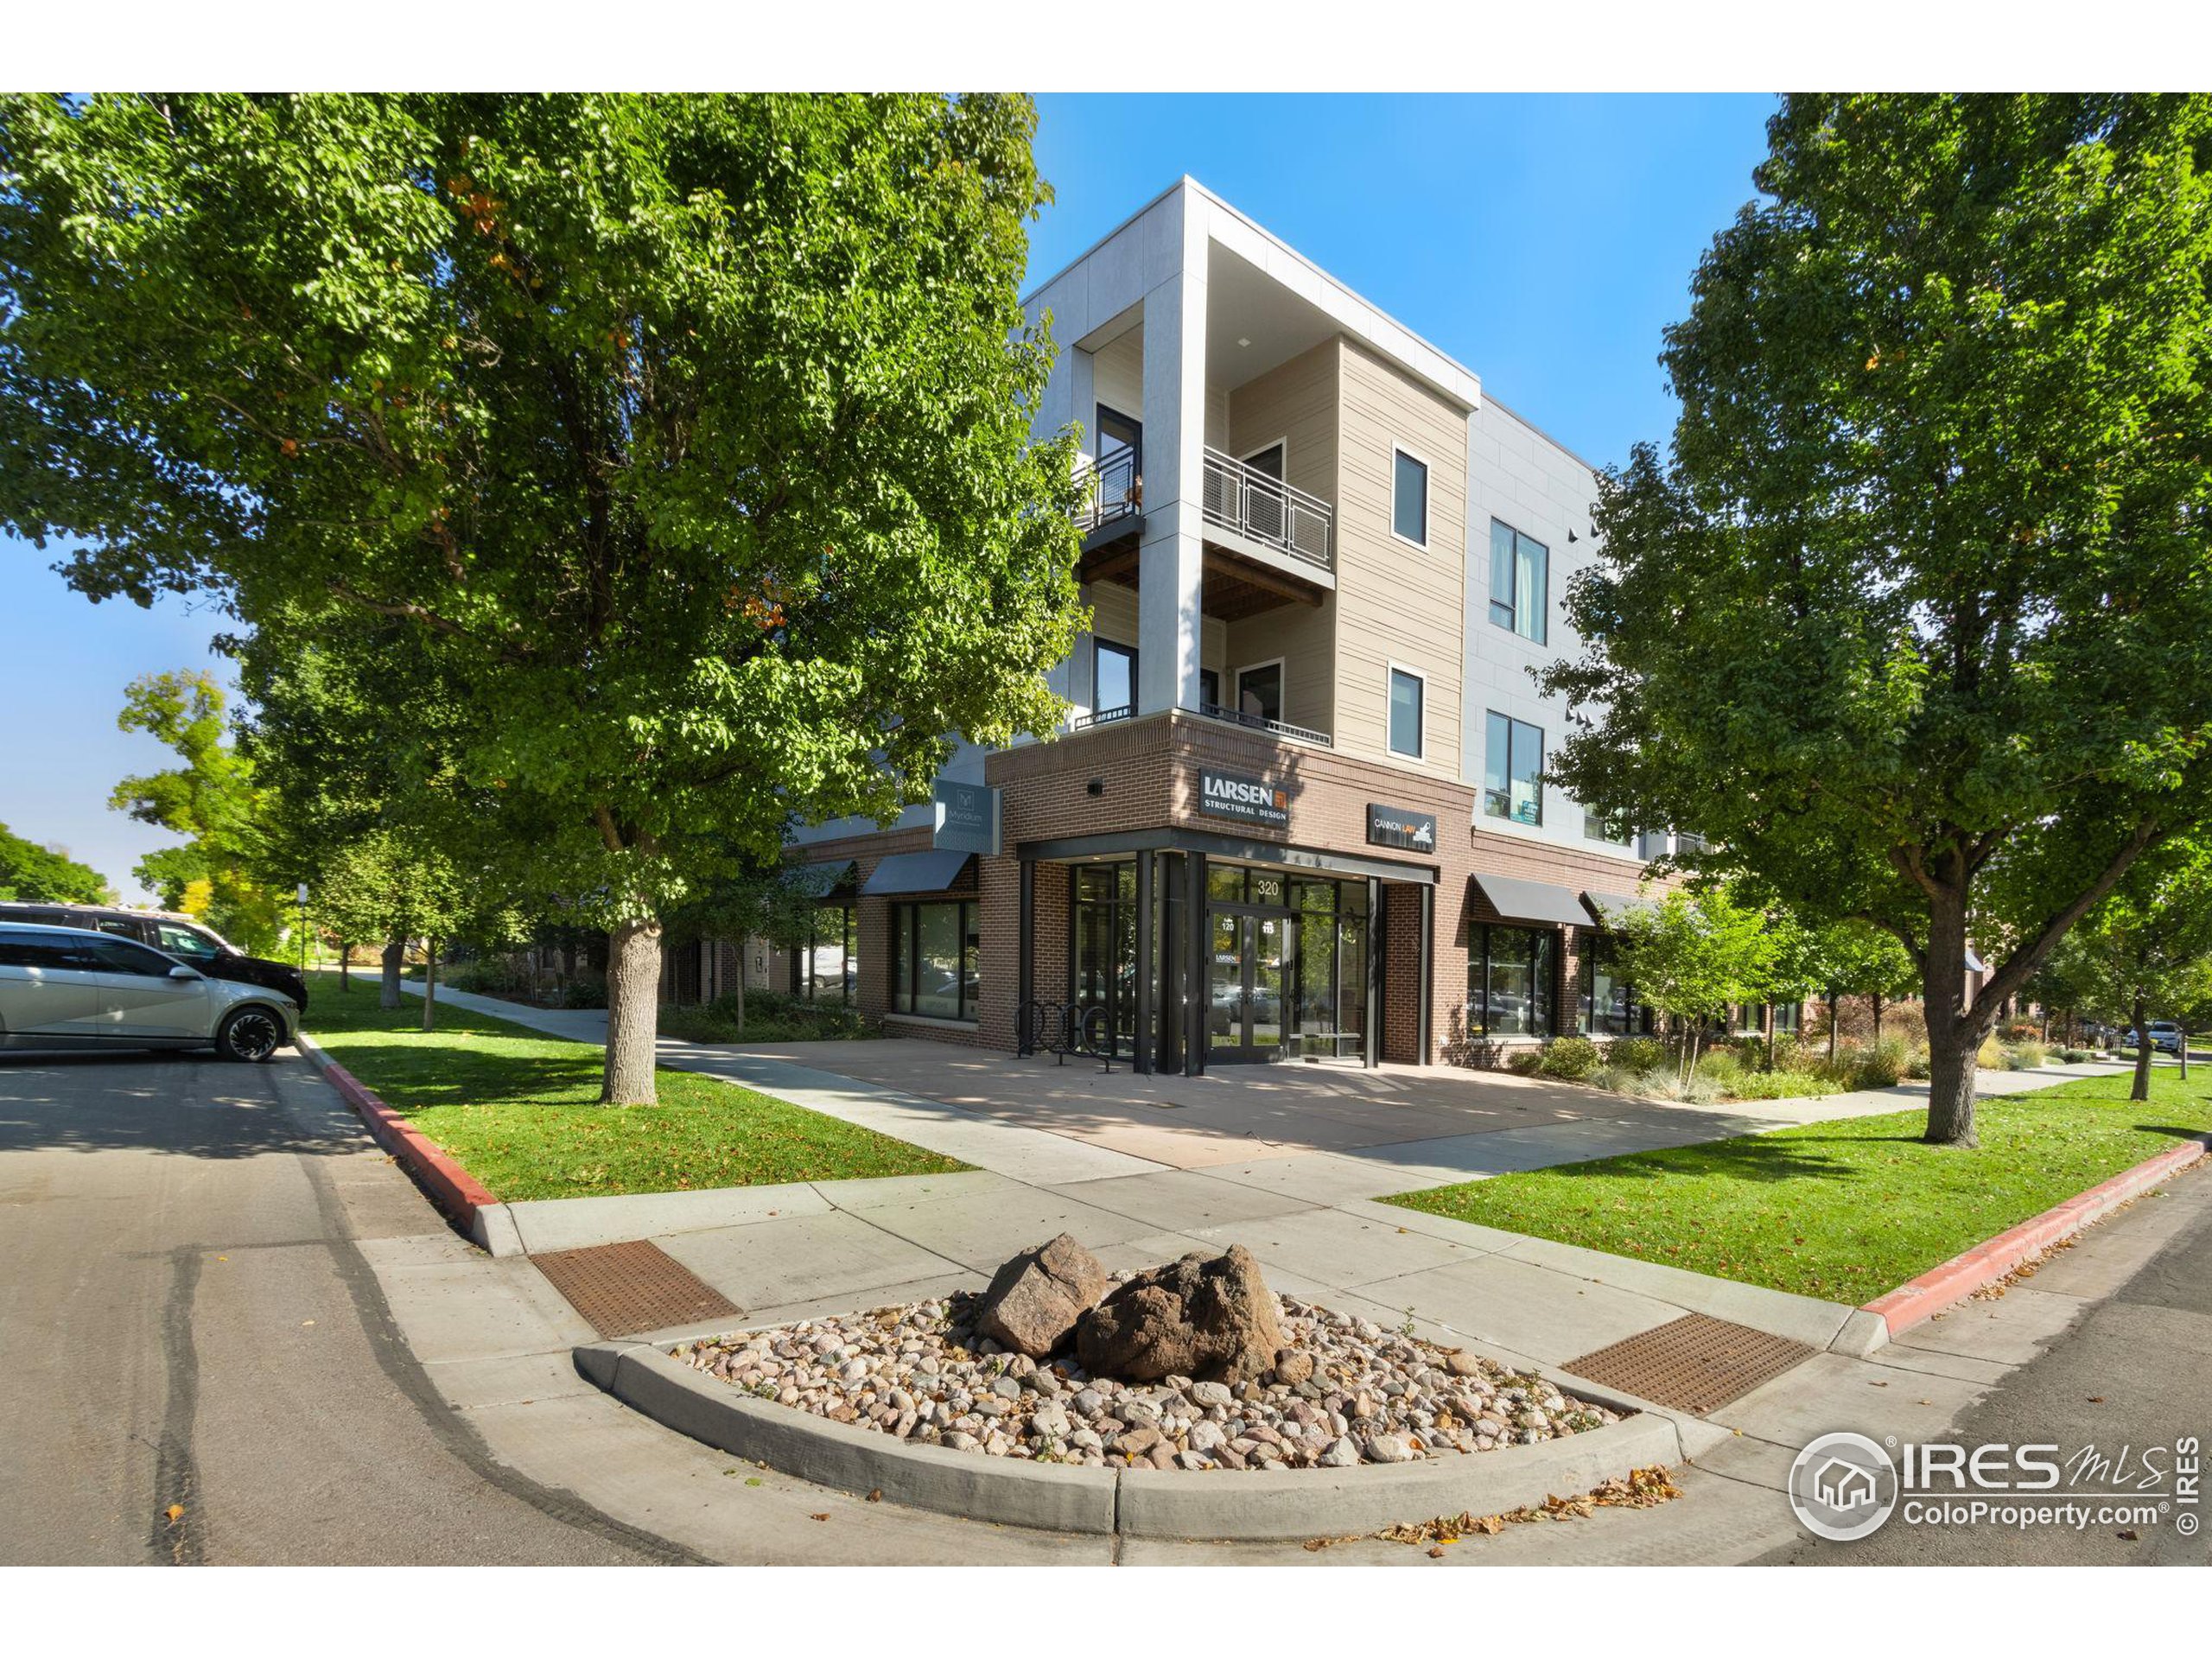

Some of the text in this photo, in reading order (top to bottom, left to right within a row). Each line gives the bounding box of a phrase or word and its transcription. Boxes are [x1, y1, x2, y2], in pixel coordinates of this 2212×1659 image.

[1205, 776, 1273, 807] LARSEN
[1205, 799, 1287, 820] STRUCTURAL DESIGN
[1374, 818, 1416, 835] CANNON LAW
[1258, 880, 1279, 895] 320
[1222, 923, 1235, 931] 120
